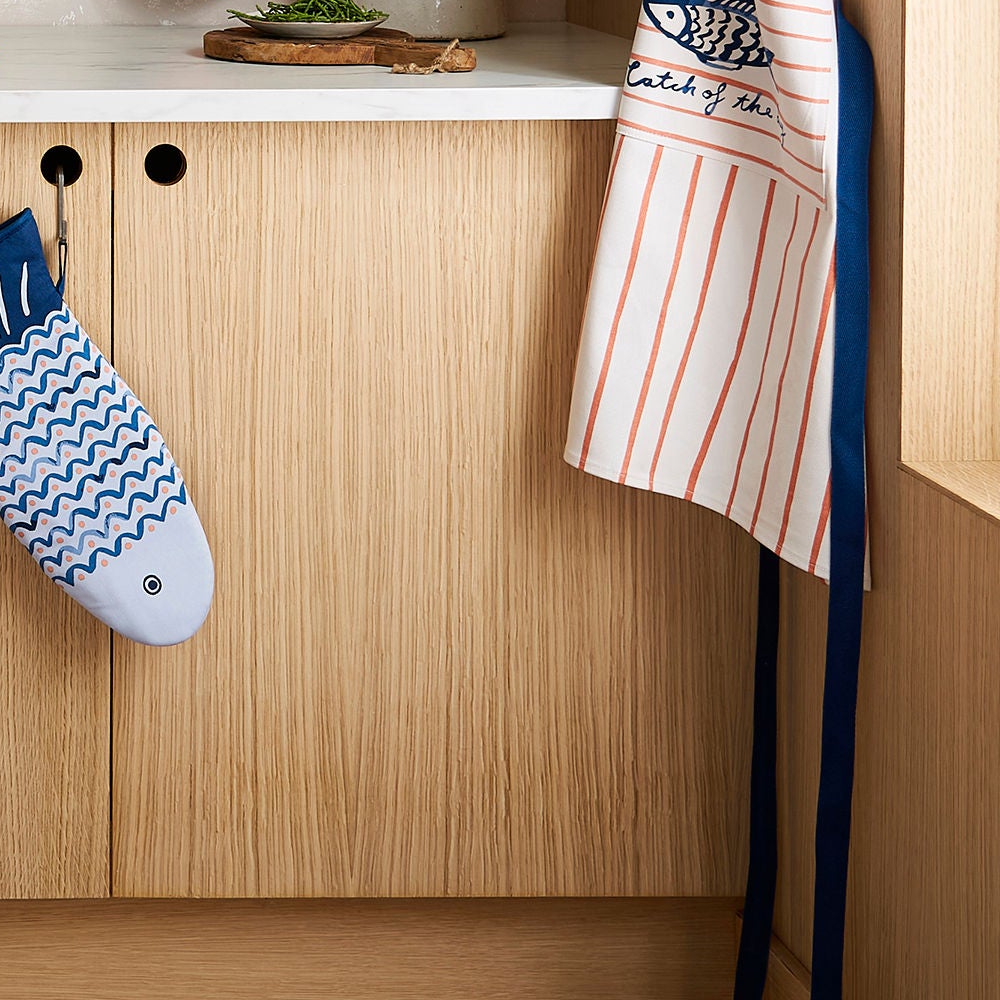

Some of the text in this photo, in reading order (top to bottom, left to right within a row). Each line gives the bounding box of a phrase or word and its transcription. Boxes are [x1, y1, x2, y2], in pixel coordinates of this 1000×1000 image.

[626, 61, 773, 118] Catch of the
